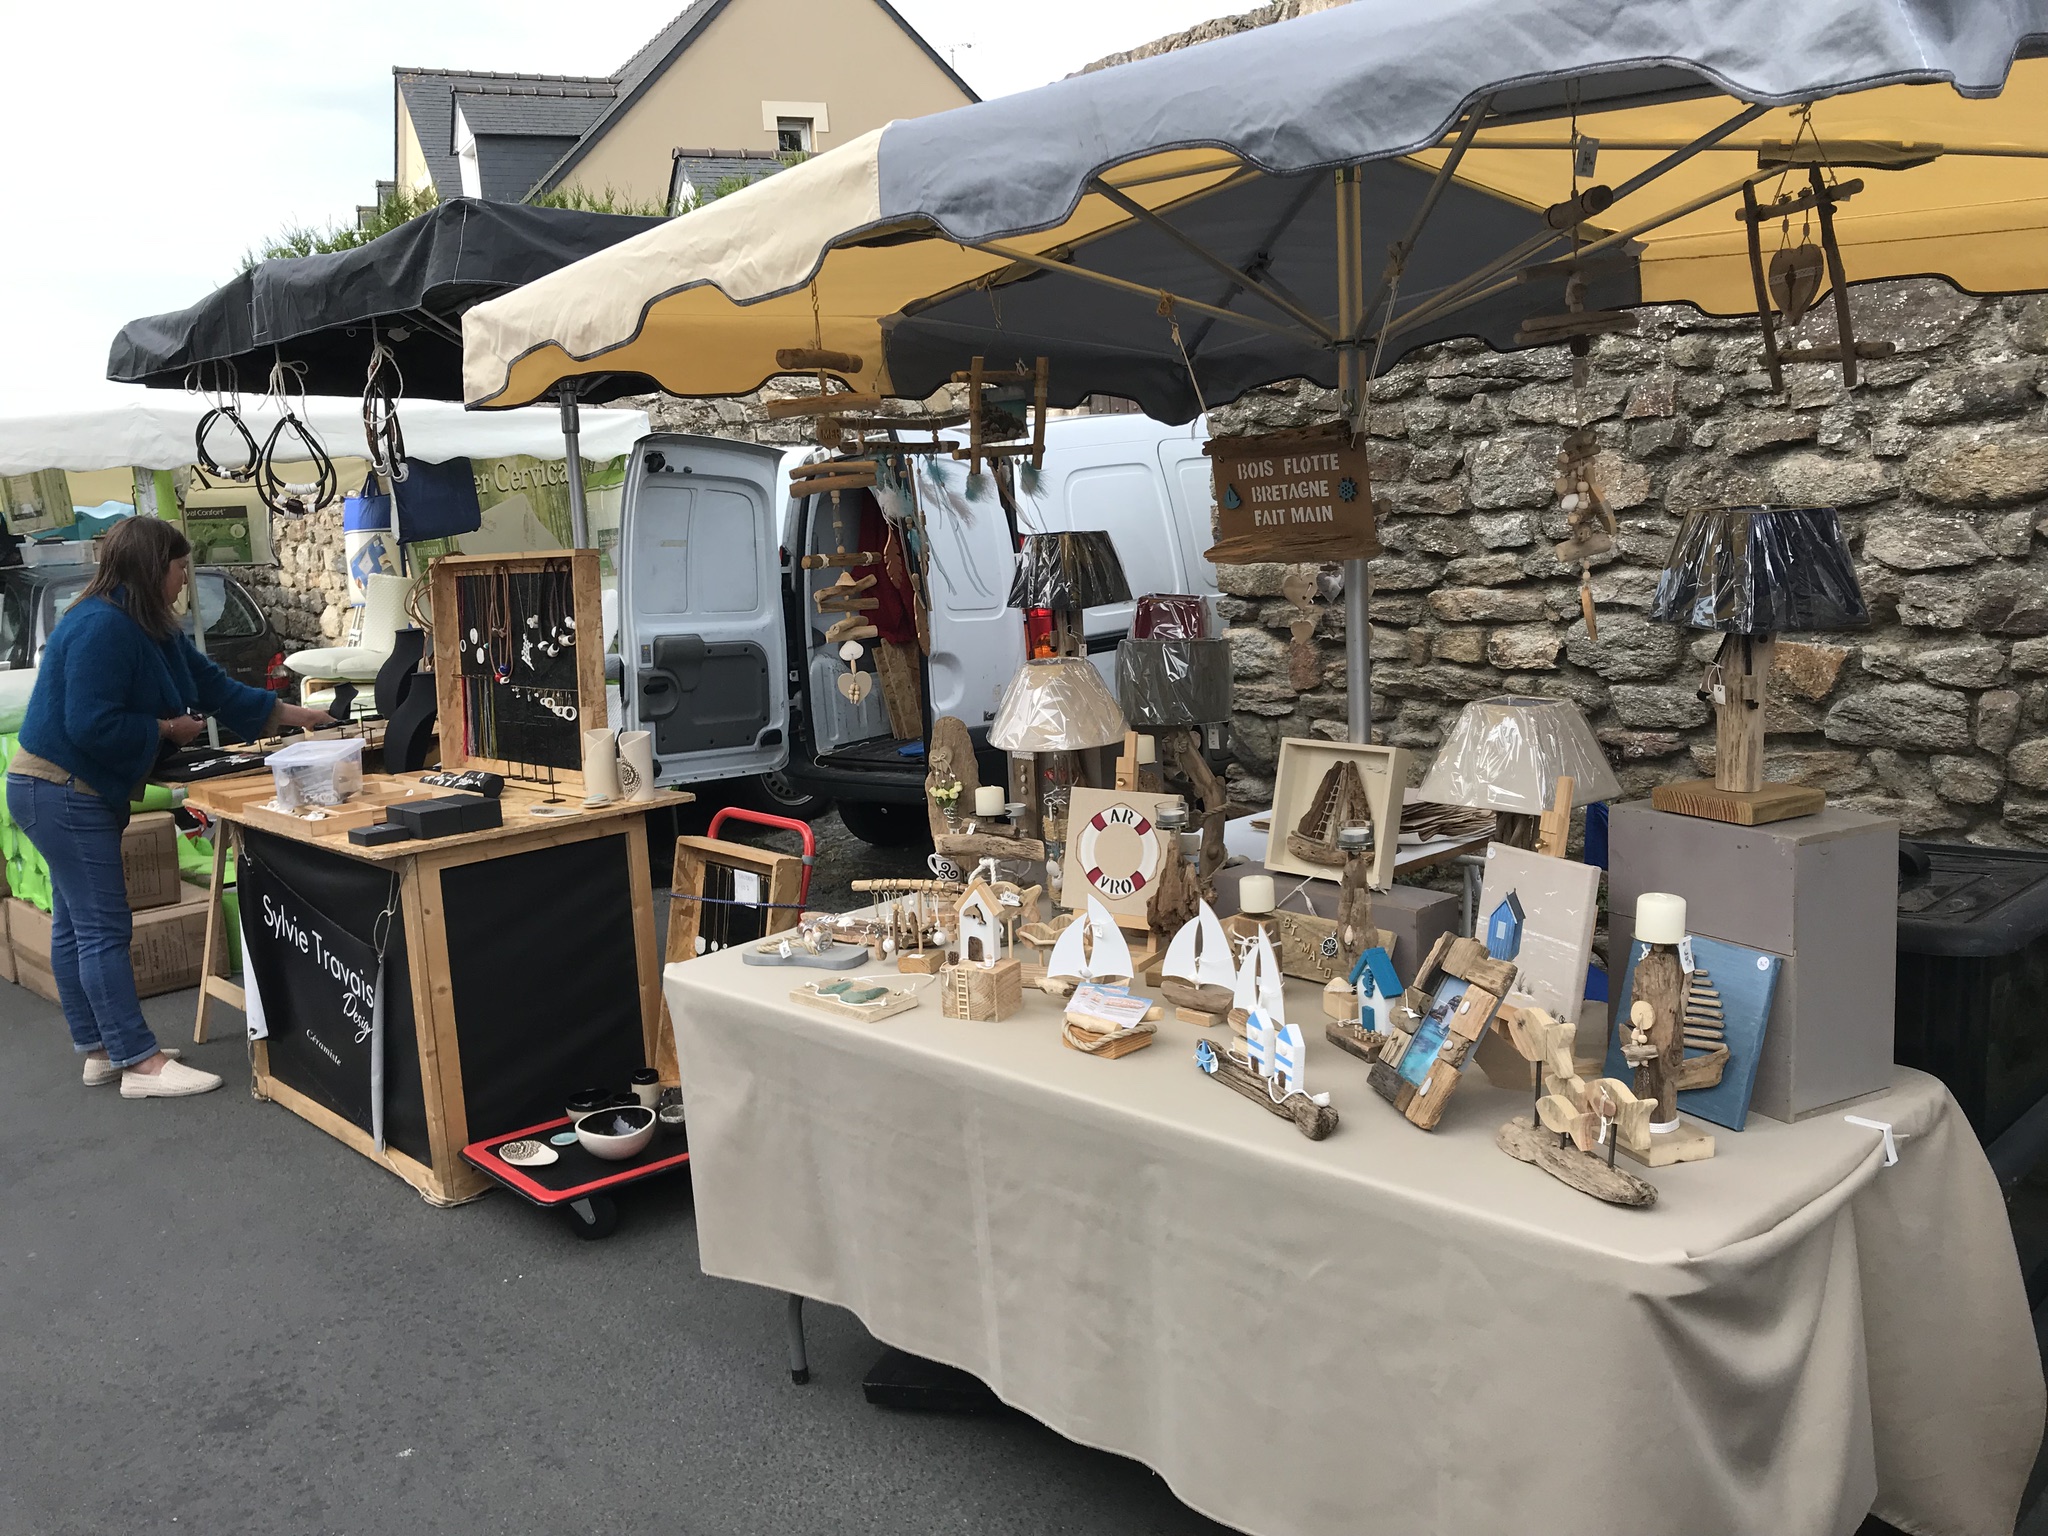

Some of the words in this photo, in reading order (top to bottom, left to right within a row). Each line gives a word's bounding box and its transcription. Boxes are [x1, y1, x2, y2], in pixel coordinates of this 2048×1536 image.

[1237, 459, 1274, 480] BOIS
[1283, 453, 1340, 475] FLOTTE
[1251, 480, 1330, 503] BRETAGNE
[1254, 509, 1286, 527] FAIT
[1290, 505, 1334, 524] MAIN
[1110, 808, 1134, 825] AR
[1100, 875, 1133, 894] VRO
[262, 894, 309, 954] Sylvie
[311, 930, 374, 1009] Travais
